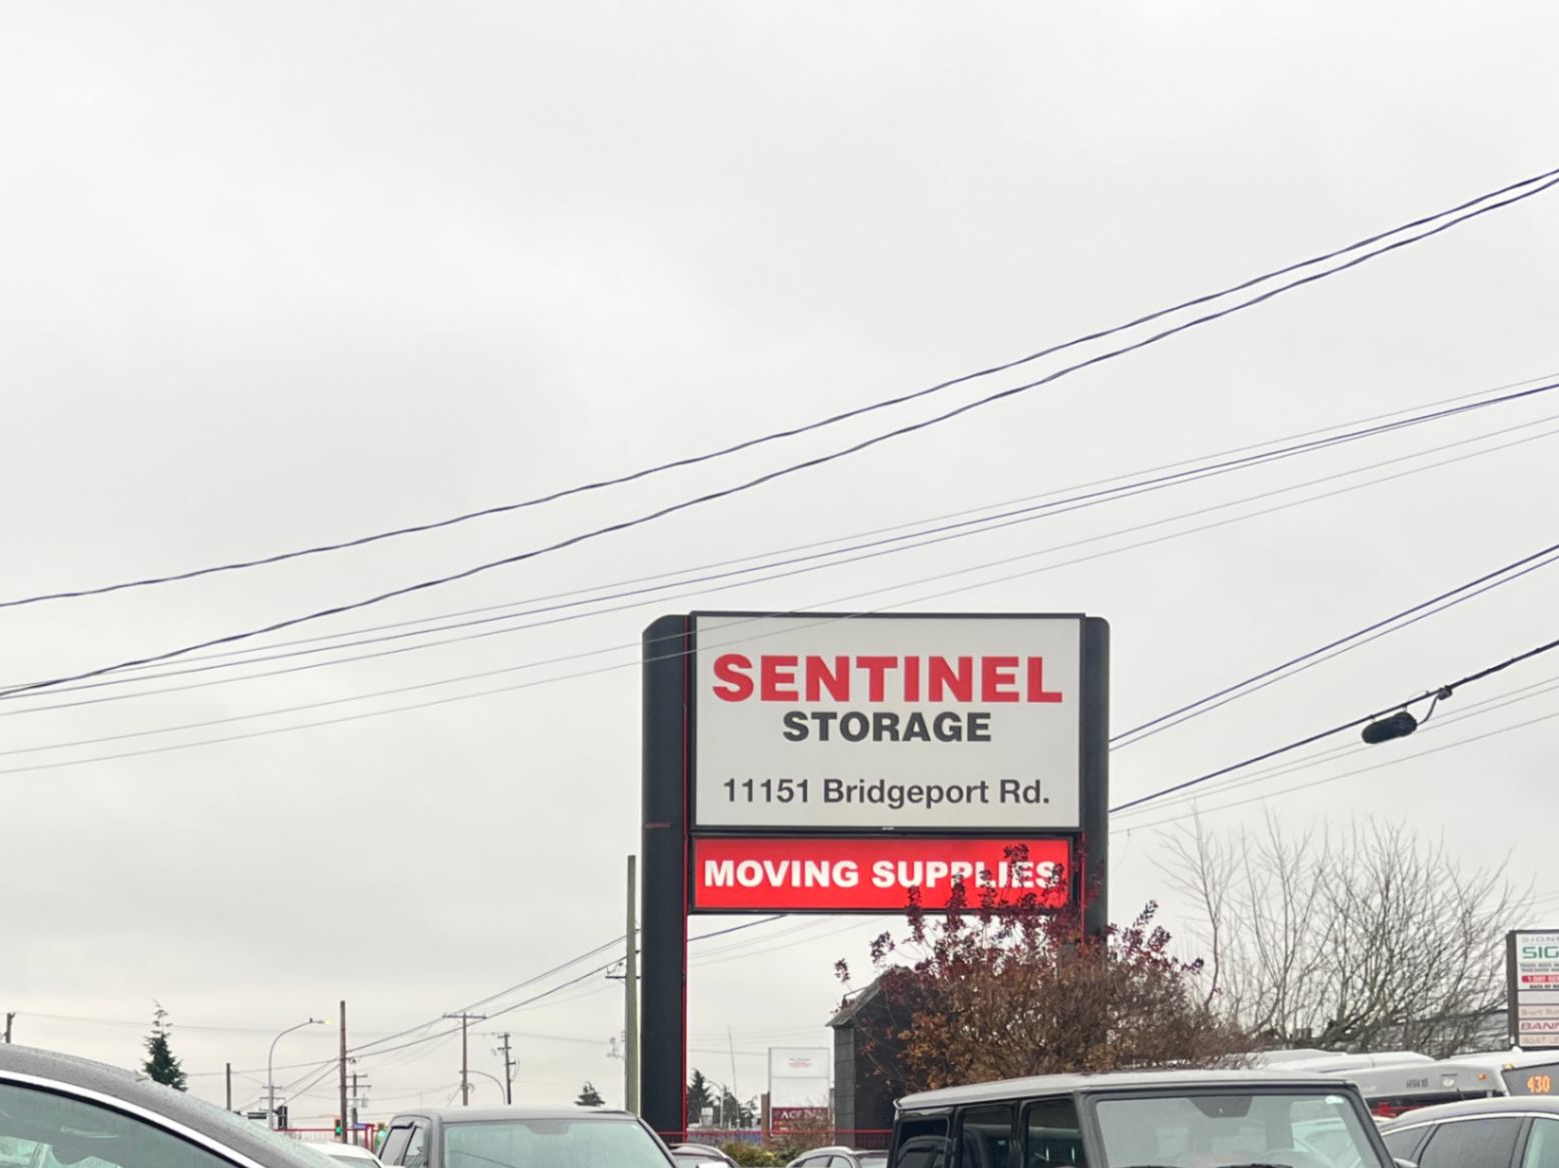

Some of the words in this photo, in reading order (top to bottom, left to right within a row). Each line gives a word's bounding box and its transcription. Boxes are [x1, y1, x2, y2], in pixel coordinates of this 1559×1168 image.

[712, 653, 1062, 703] SENTINEL
[782, 711, 992, 742] STORAGE
[723, 779, 810, 803] 11151
[823, 779, 989, 809] Bridgeport
[1000, 779, 1050, 804] Rd.
[704, 860, 859, 887] MOVING
[872, 860, 1059, 888] SUPPLIES
[1527, 1075, 1550, 1093] 430
